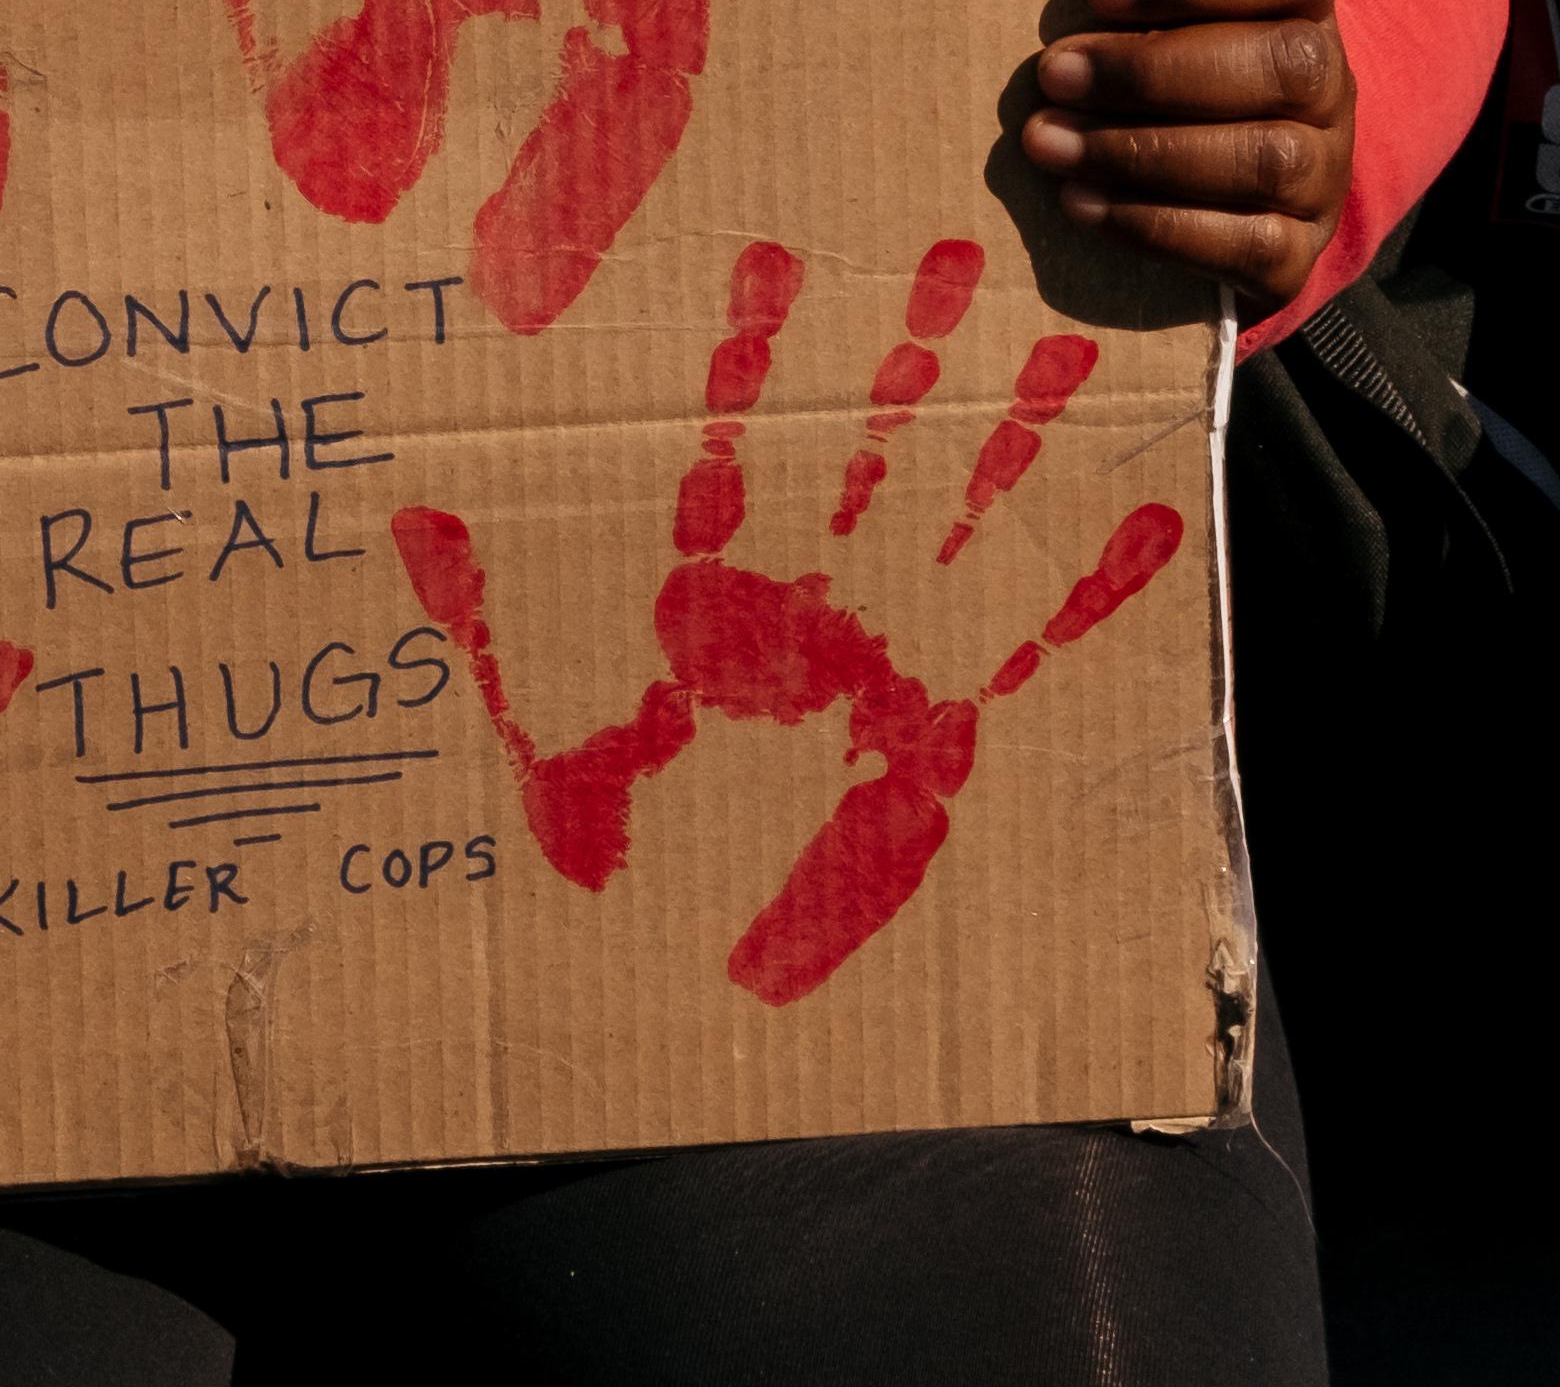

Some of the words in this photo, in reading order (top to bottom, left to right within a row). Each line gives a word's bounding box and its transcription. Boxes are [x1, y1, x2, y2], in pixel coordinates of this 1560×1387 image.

[127, 390, 396, 490] THE
[40, 491, 366, 609] REAL
[35, 626, 451, 757] THUGS
[338, 833, 497, 894] COPS
